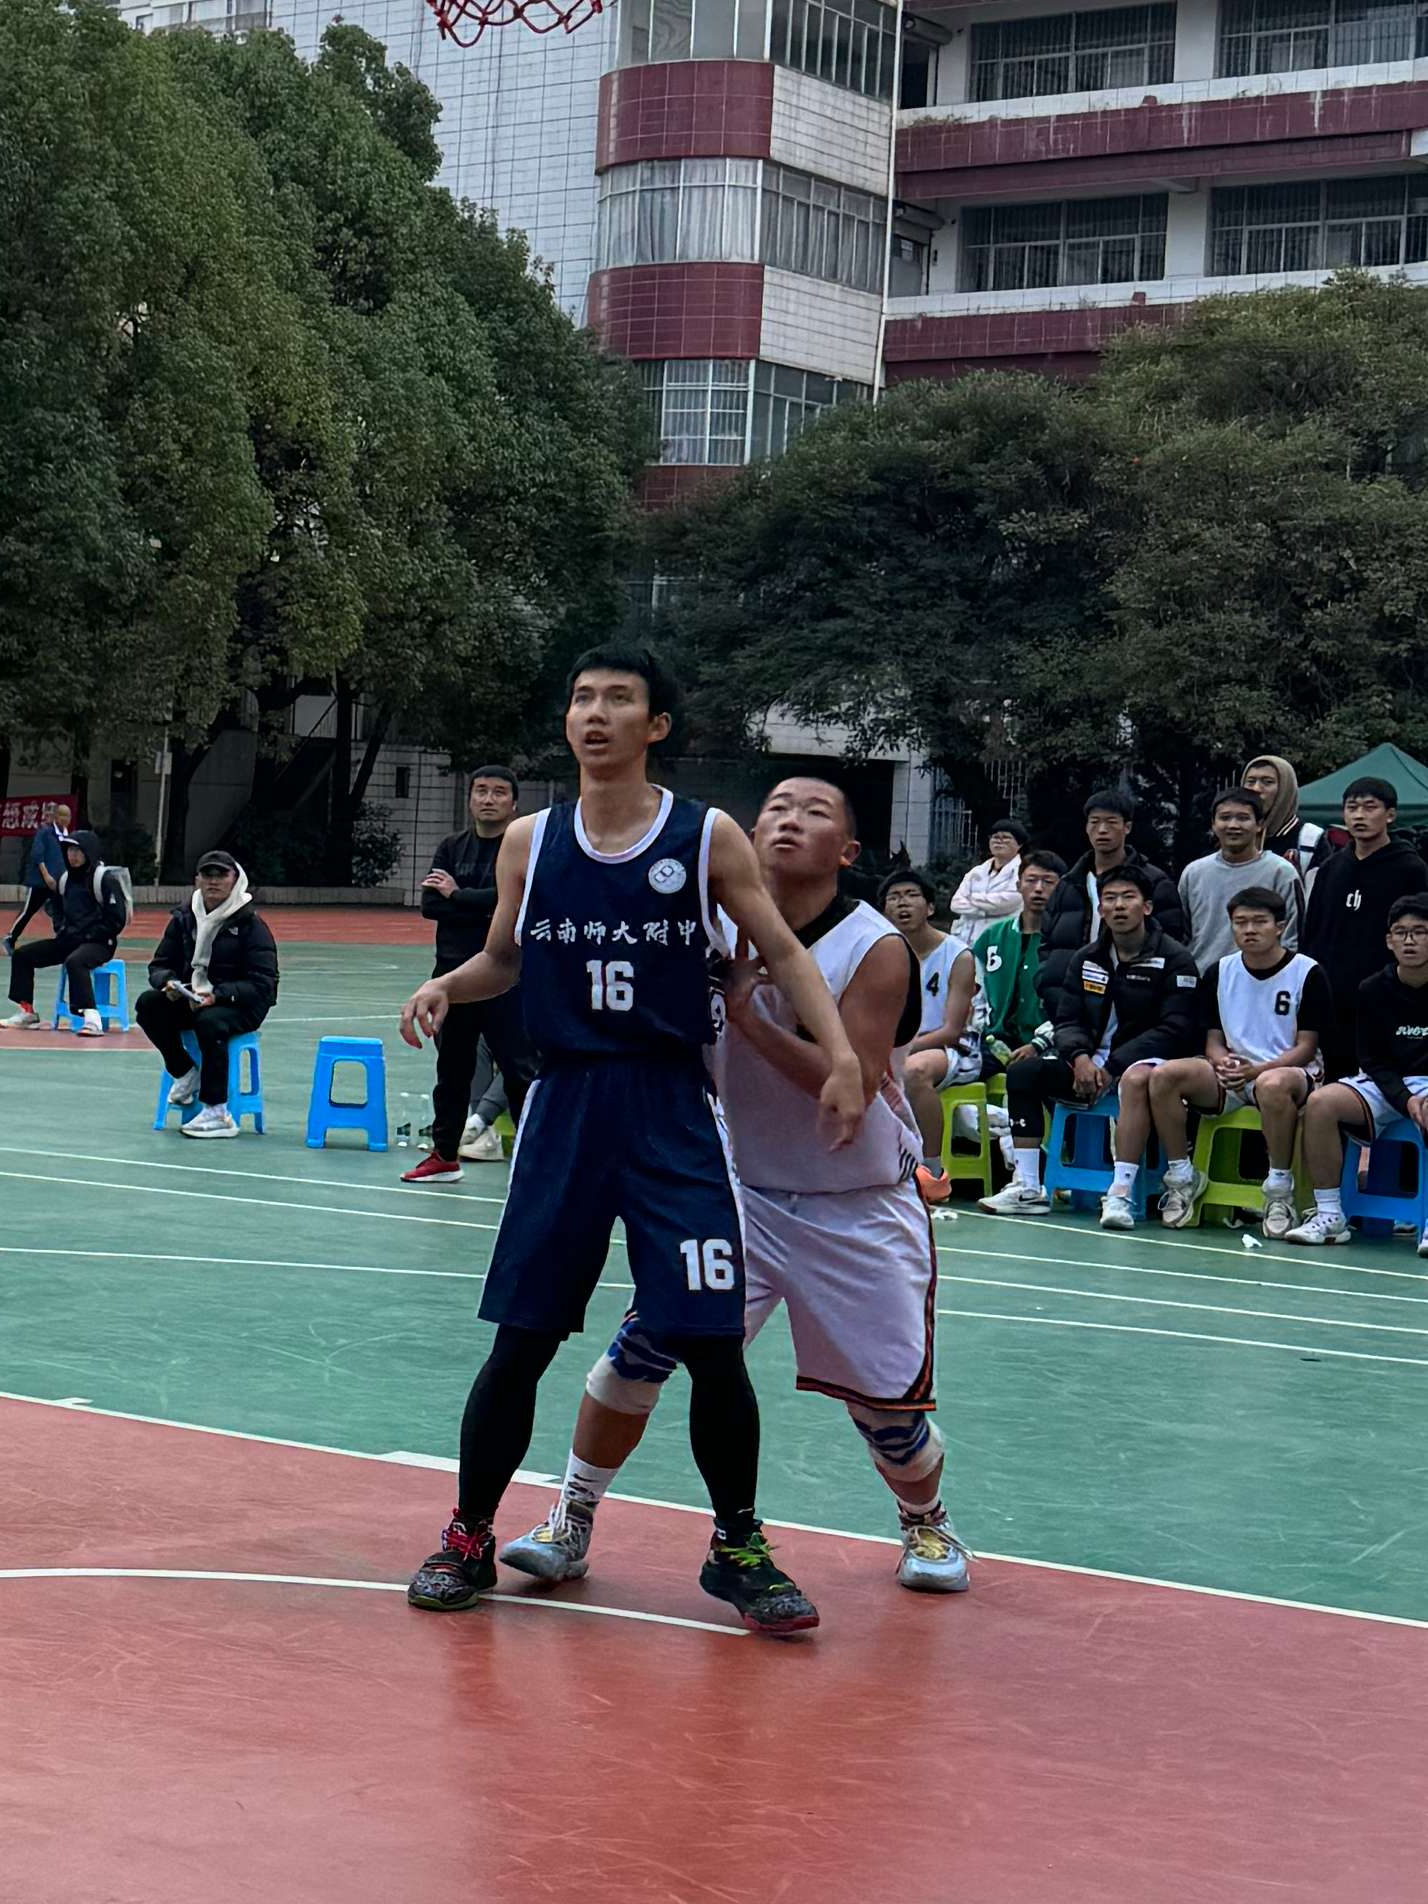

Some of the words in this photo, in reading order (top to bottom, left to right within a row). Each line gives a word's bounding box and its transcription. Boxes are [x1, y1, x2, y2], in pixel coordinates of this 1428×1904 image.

[530, 918, 697, 945] 云南师大附中
[585, 960, 635, 1011] 16
[926, 971, 940, 997] 4
[1274, 990, 1291, 1016] 6
[679, 1238, 736, 1291] 16
